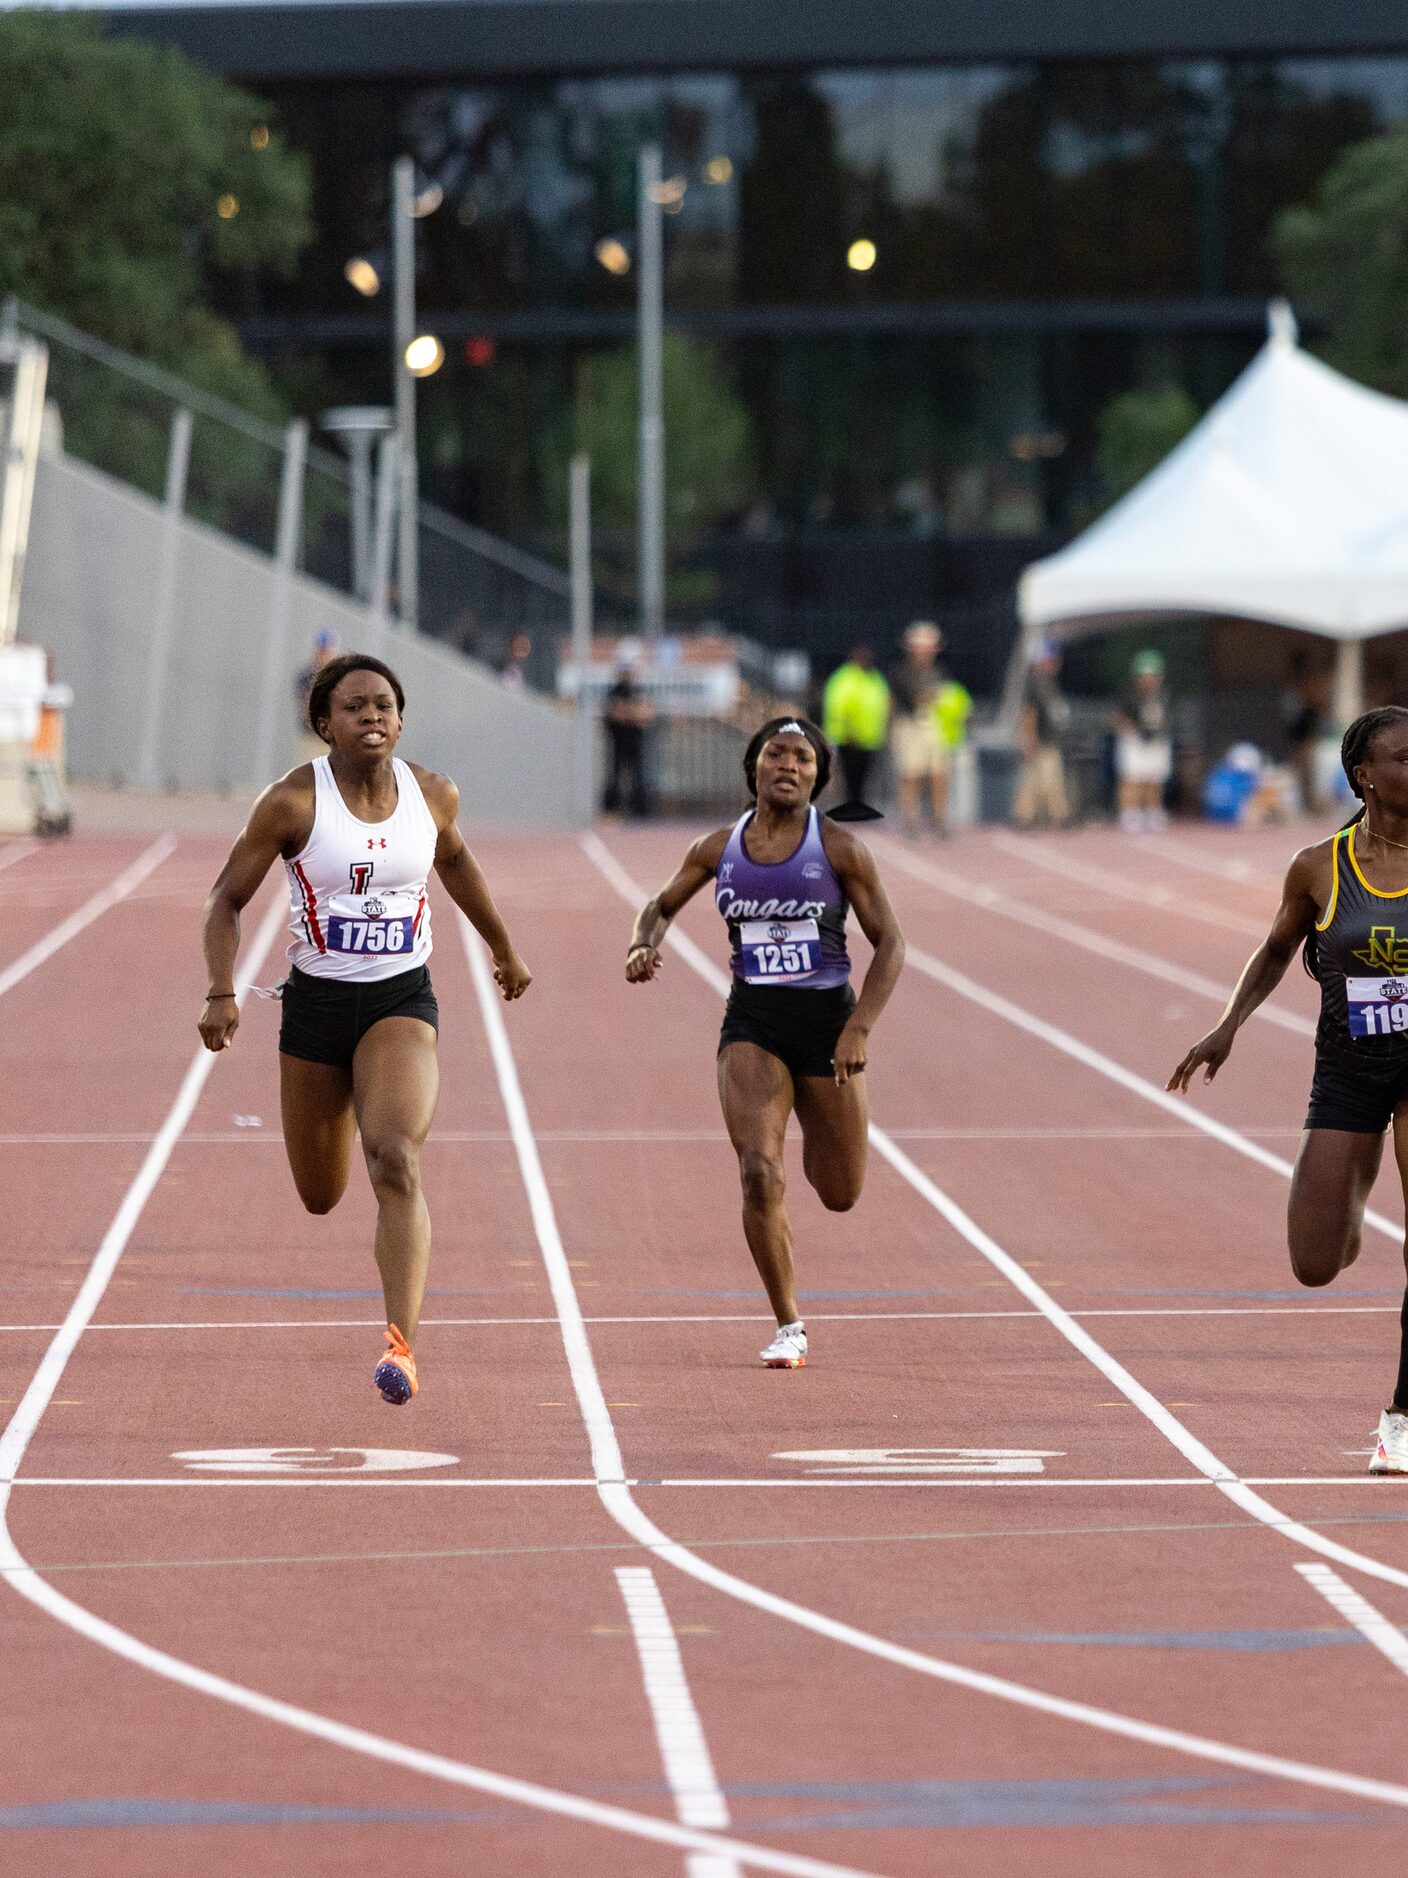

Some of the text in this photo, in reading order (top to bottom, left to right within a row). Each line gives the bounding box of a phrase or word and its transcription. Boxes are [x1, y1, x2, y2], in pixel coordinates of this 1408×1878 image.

[716, 887, 826, 920] Cougars
[338, 920, 404, 952] 1756
[753, 943, 812, 974] 1251
